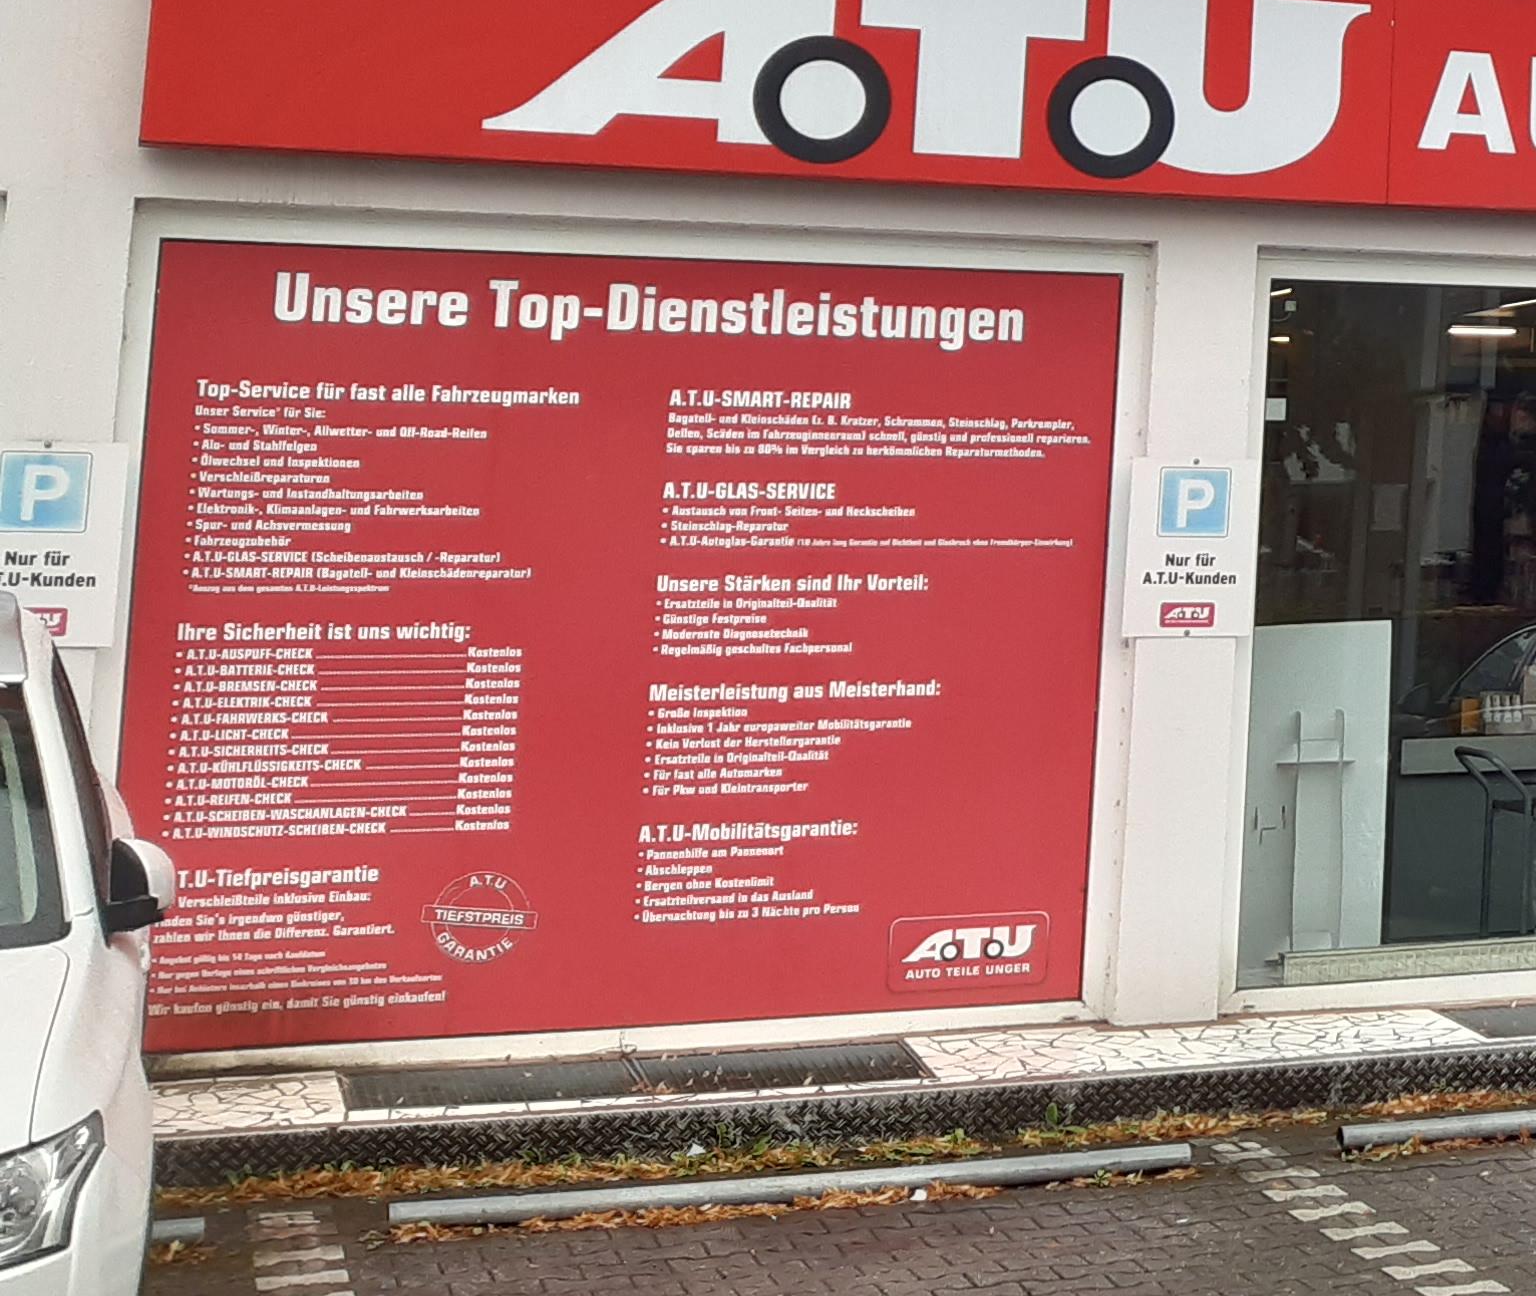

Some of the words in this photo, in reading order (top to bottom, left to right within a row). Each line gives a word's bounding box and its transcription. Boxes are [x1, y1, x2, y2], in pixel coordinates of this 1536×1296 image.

[274, 272, 468, 324] Unsere
[489, 278, 1025, 351] Top-Dienstleistungen
[199, 380, 310, 399] Top-Service
[316, 382, 345, 399] für
[350, 383, 386, 400] fast
[391, 384, 425, 401] alle
[431, 385, 579, 405] Fahrzeugmarken
[669, 390, 851, 408] A.T.U-SMART-REPAIR
[20, 464, 70, 521] P
[663, 482, 835, 499] A.T.U-GLAS-SERVICE
[1176, 479, 1215, 528] P
[4, 550, 38, 566] Nur
[44, 550, 70, 566] für
[1165, 554, 1191, 566] Nur
[1195, 552, 1216, 566] für
[657, 575, 718, 591] Unsere
[724, 575, 791, 591] Stärken
[796, 575, 832, 590] sind
[837, 574, 862, 590] Ihr
[867, 574, 928, 590] Vorteil:
[1142, 571, 1237, 585] A.T.U-Kunden
[177, 623, 217, 640] Ihre
[223, 623, 322, 640] Sicherheit
[327, 623, 352, 639] ist
[357, 626, 390, 639] uns
[396, 622, 470, 641] wichtig:
[186, 648, 312, 659] A.T.U-AUSPUFF-CHECK
[468, 646, 522, 657] Kostenlos
[184, 664, 314, 675] A.T.U-BATTERIE-CHECK
[467, 662, 521, 672] Kostenlos
[183, 680, 317, 691] A.T.U-BREMSEN-CHECK
[466, 678, 520, 688] Kostenlos
[649, 684, 788, 701] Meisterleistung
[793, 685, 823, 698] aus
[829, 680, 940, 697] Meisterhand:
[182, 696, 312, 708] A.T.U-ELEKTRIK-CHECK
[464, 693, 518, 704] Kostenlos
[181, 711, 328, 724] A.T.U-FAHRWERKS-CHECK
[463, 709, 517, 720] Kostenlos
[179, 728, 288, 740] A.T.U-LICHT-CHECK
[462, 725, 516, 735] Kostenlos
[178, 744, 328, 756] A.T.U-SICHERHEITS-CHECK
[461, 740, 515, 751] Kostenlos
[177, 759, 361, 772] A.T.U-KÜHLFLÜSSIGKEITS-CHECK
[460, 756, 514, 767] Kostenlos
[176, 776, 308, 789] A.T.U-MOTORÖL-CHECK
[459, 772, 513, 783] Kostenlos
[174, 792, 291, 805] A.T.U-REIFEN-CHECK
[458, 788, 512, 799] Kostenlos
[173, 806, 406, 821] A.T.U-SCHEIBEN-WASCHANLAGEN-CHECK
[457, 804, 511, 814] Kostenlos
[172, 822, 386, 838] A.T.U-WINDSCHUTZ-SCHEIBEN-CHECK
[455, 820, 509, 830] Kostenlos
[638, 821, 857, 841] A.T.U-Mobilitätsgarantie:
[177, 866, 378, 889] T.U-Tiefpreisgarantie
[178, 894, 270, 907] Verschleißteile
[272, 892, 325, 904] inklusive
[328, 890, 370, 902] Einbau:
[154, 915, 192, 927] inden
[435, 908, 525, 927] TIEFSTPREIS
[437, 931, 514, 963] GARANTIE
[905, 968, 940, 978] AUTO
[945, 965, 979, 976] TEILE
[985, 963, 1029, 974] UNGER
